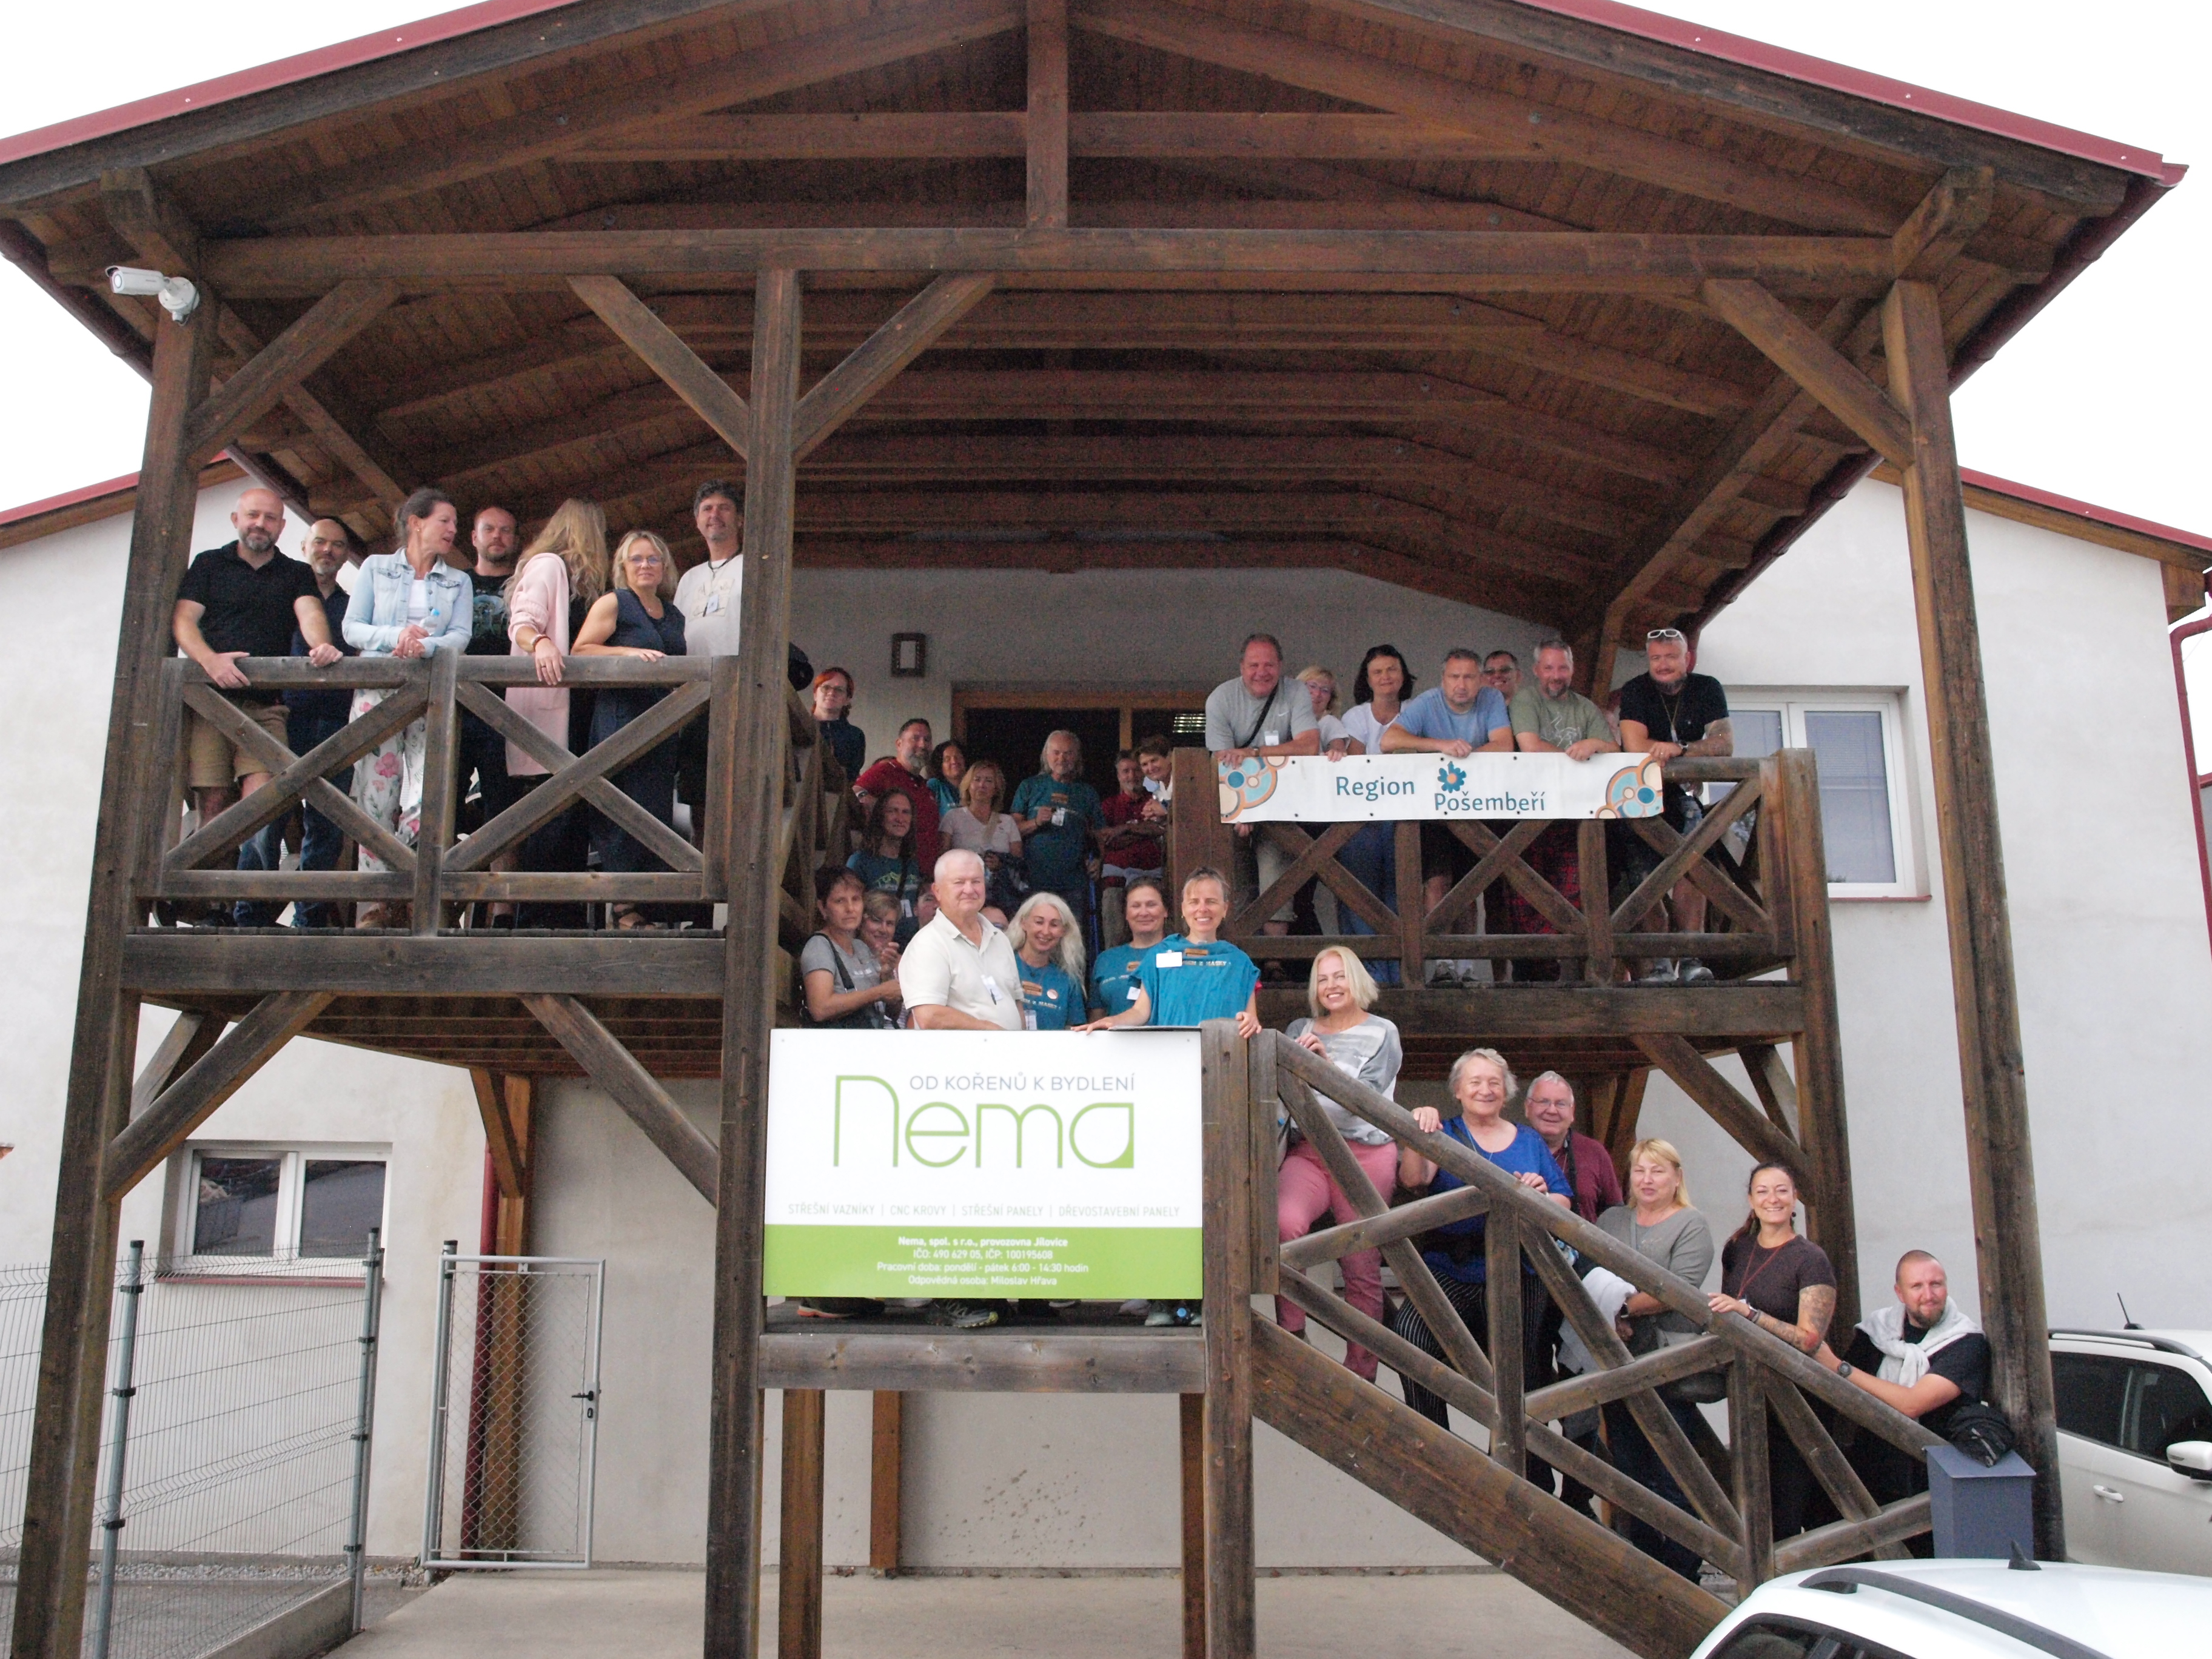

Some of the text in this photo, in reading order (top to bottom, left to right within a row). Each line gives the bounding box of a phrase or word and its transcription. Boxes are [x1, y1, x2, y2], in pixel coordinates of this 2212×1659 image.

[1336, 776, 1415, 802] Region
[1434, 791, 1546, 811] Pošembeří
[910, 1071, 1135, 1091] OD KOŘENŮ K BYDLENÍ
[788, 1202, 1180, 1217] STŘEŠNÍ VAZNÍKY CNC KROVY STŘEŠNÍ PANELY DŘEVOSTAVEBNÍ PANELY
[898, 1236, 927, 1246] Nema,
[928, 1237, 950, 1247] spol.
[960, 1238, 978, 1247] r.o.,
[980, 1239, 1031, 1247] provozovna
[933, 1250, 950, 1258] 490
[951, 1250, 968, 1258] 629
[970, 1250, 983, 1259] 05,
[1006, 1250, 1053, 1259] 100195608
[877, 1261, 916, 1271] Pracovní
[917, 1262, 941, 1272] doba:
[944, 1262, 977, 1273] pondělí
[985, 1262, 1009, 1273] pátek
[1011, 1262, 1030, 1272] 6:00
[1039, 1263, 1062, 1272] 14:30
[1064, 1263, 1088, 1272] hodin
[908, 1275, 958, 1285] Odpovědná
[960, 1276, 989, 1285] osoba:
[991, 1276, 1028, 1285] Miloslav
